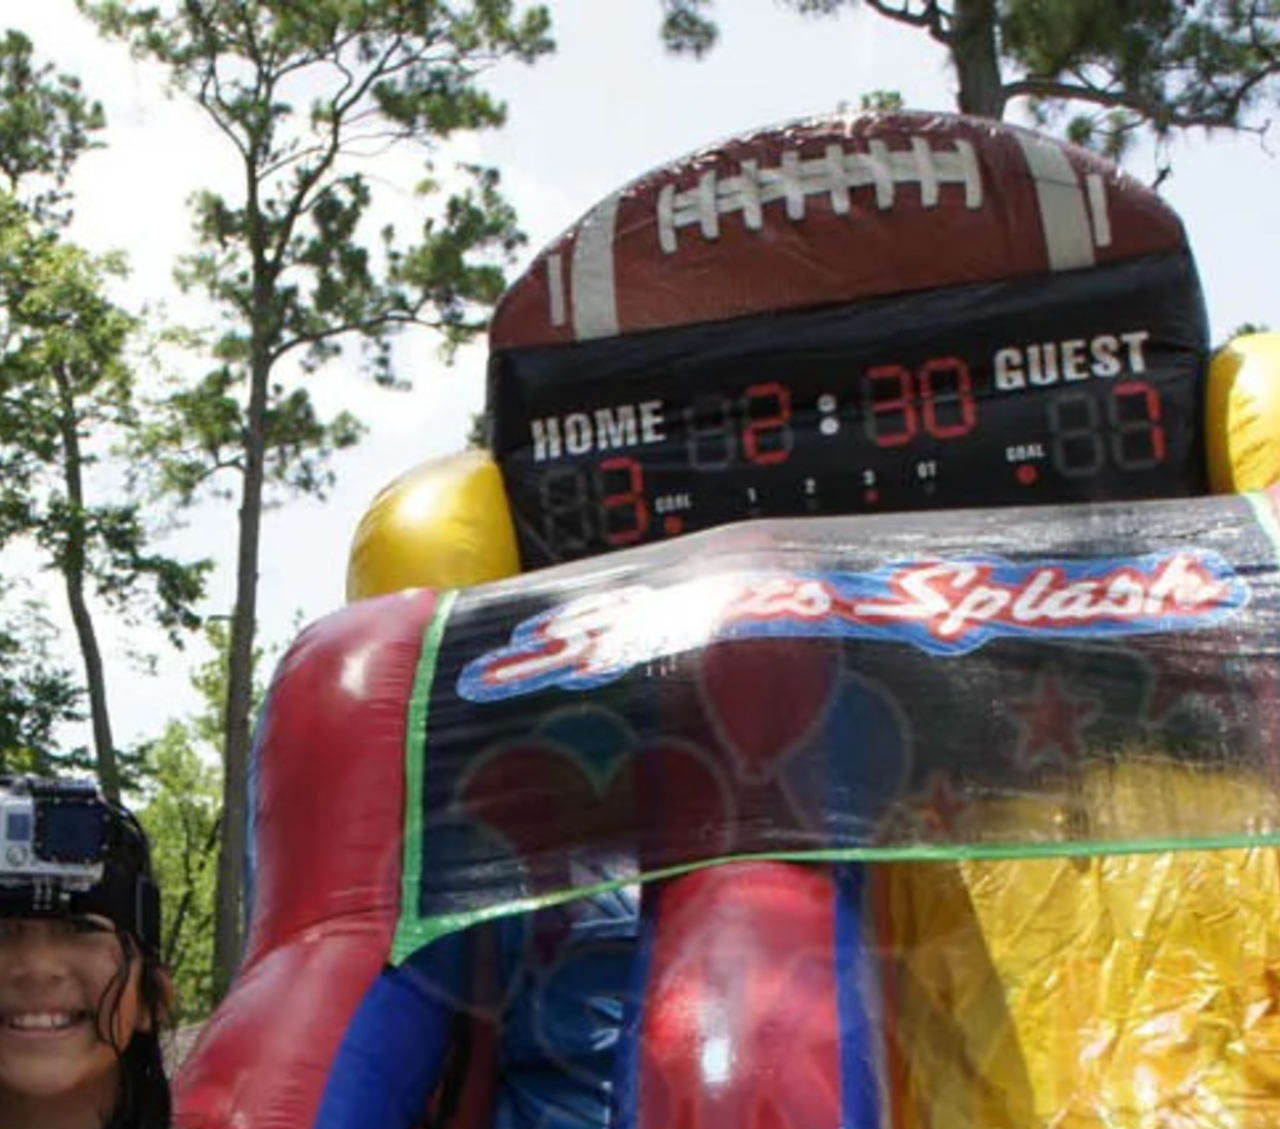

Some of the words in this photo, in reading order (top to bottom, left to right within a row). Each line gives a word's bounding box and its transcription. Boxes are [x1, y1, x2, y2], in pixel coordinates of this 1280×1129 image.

[994, 329, 1150, 391] GUEST
[530, 400, 667, 463] HOME
[853, 552, 1230, 638] Splash
